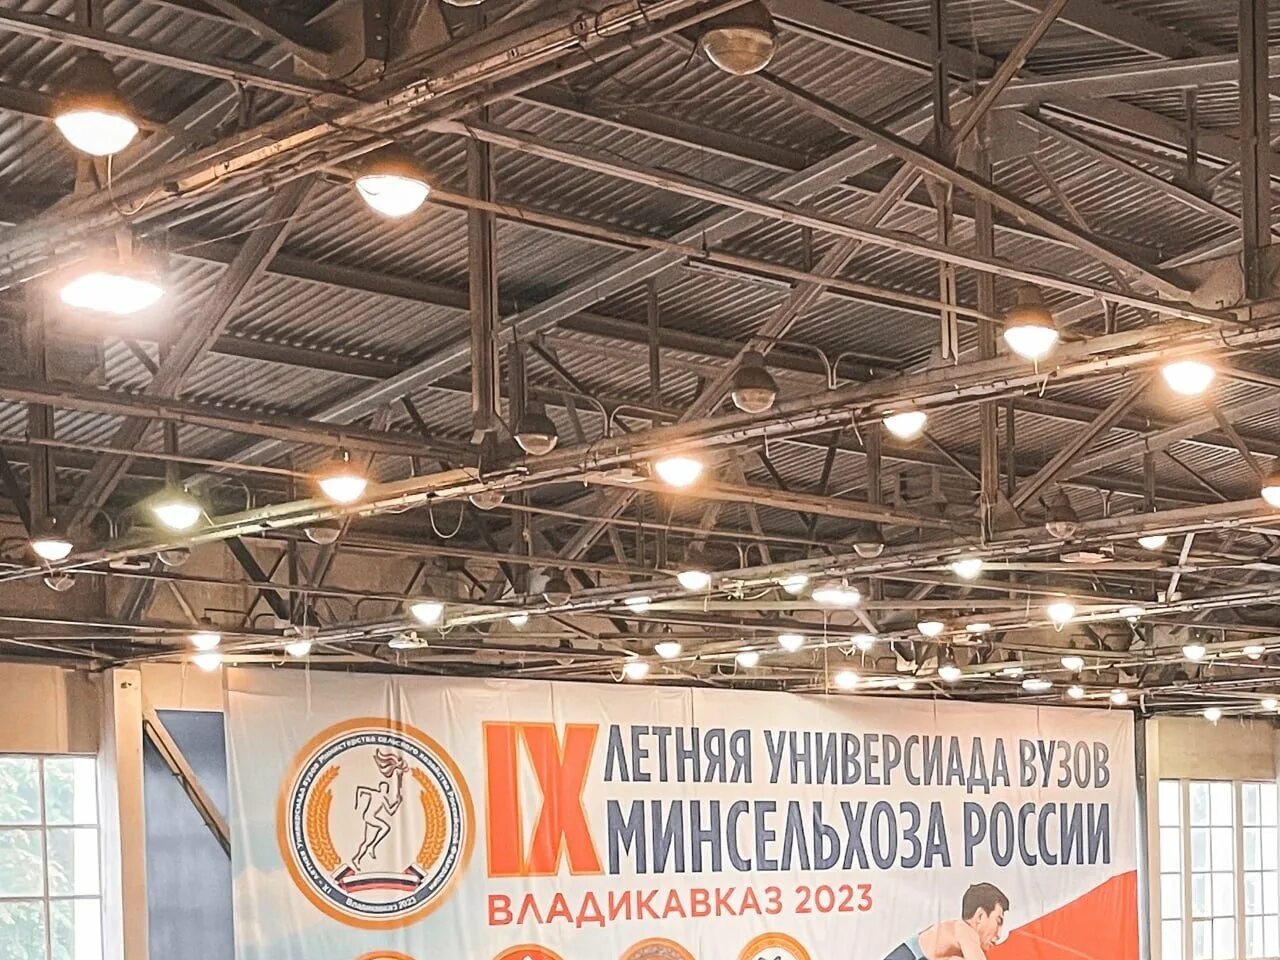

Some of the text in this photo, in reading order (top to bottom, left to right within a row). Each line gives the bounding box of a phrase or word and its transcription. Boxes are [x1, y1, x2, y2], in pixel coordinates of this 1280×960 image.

[604, 724, 1111, 794] ЛЕТНЯЯ УНИВЕРСИАДА ВУЗОВ
[483, 721, 605, 878] IX
[607, 800, 1111, 875] МИНСЕЛЬХОЗА РОССИИ
[487, 883, 873, 930] ВЛАДИКАВКАЗ 2023
